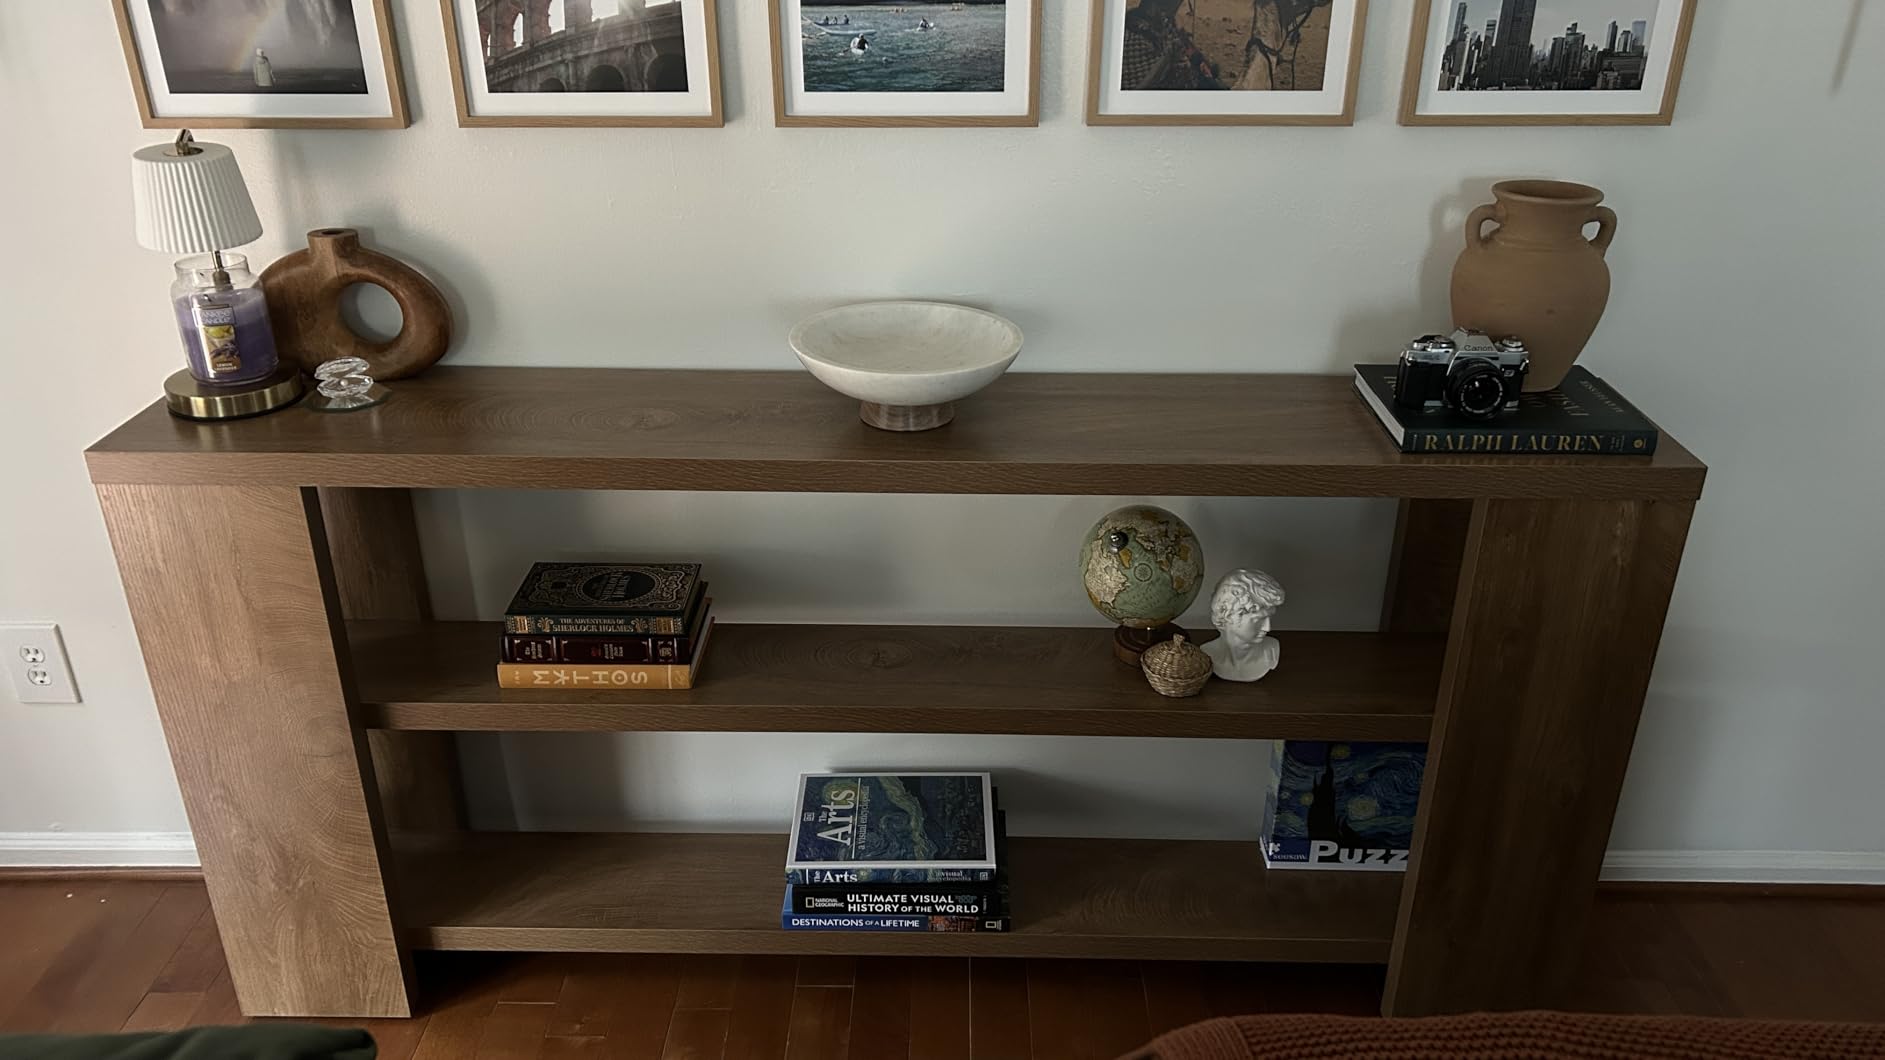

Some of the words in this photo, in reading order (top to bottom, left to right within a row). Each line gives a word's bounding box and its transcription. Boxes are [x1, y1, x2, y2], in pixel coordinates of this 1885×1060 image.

[1464, 344, 1493, 352] Canon
[1423, 434, 1502, 450] RALPH
[1510, 435, 1604, 451] LAUREN
[574, 617, 617, 625] ADVENTURES
[617, 617, 626, 625] OF
[552, 624, 600, 632] SHERLOCK
[600, 624, 634, 632] HOLMES
[816, 789, 856, 847] Arts
[818, 810, 828, 823] The
[857, 824, 867, 845] visual
[813, 870, 821, 883] The
[822, 870, 858, 883] Arts
[846, 893, 908, 903] ULTIMATE
[910, 894, 955, 904] VISUAL
[848, 903, 900, 912] HISTORY
[900, 905, 913, 913] OF
[914, 905, 932, 913] THE
[934, 904, 979, 913] WORLD
[791, 918, 864, 926] DESTINATIONS
[880, 918, 920, 928] LIFETIME
